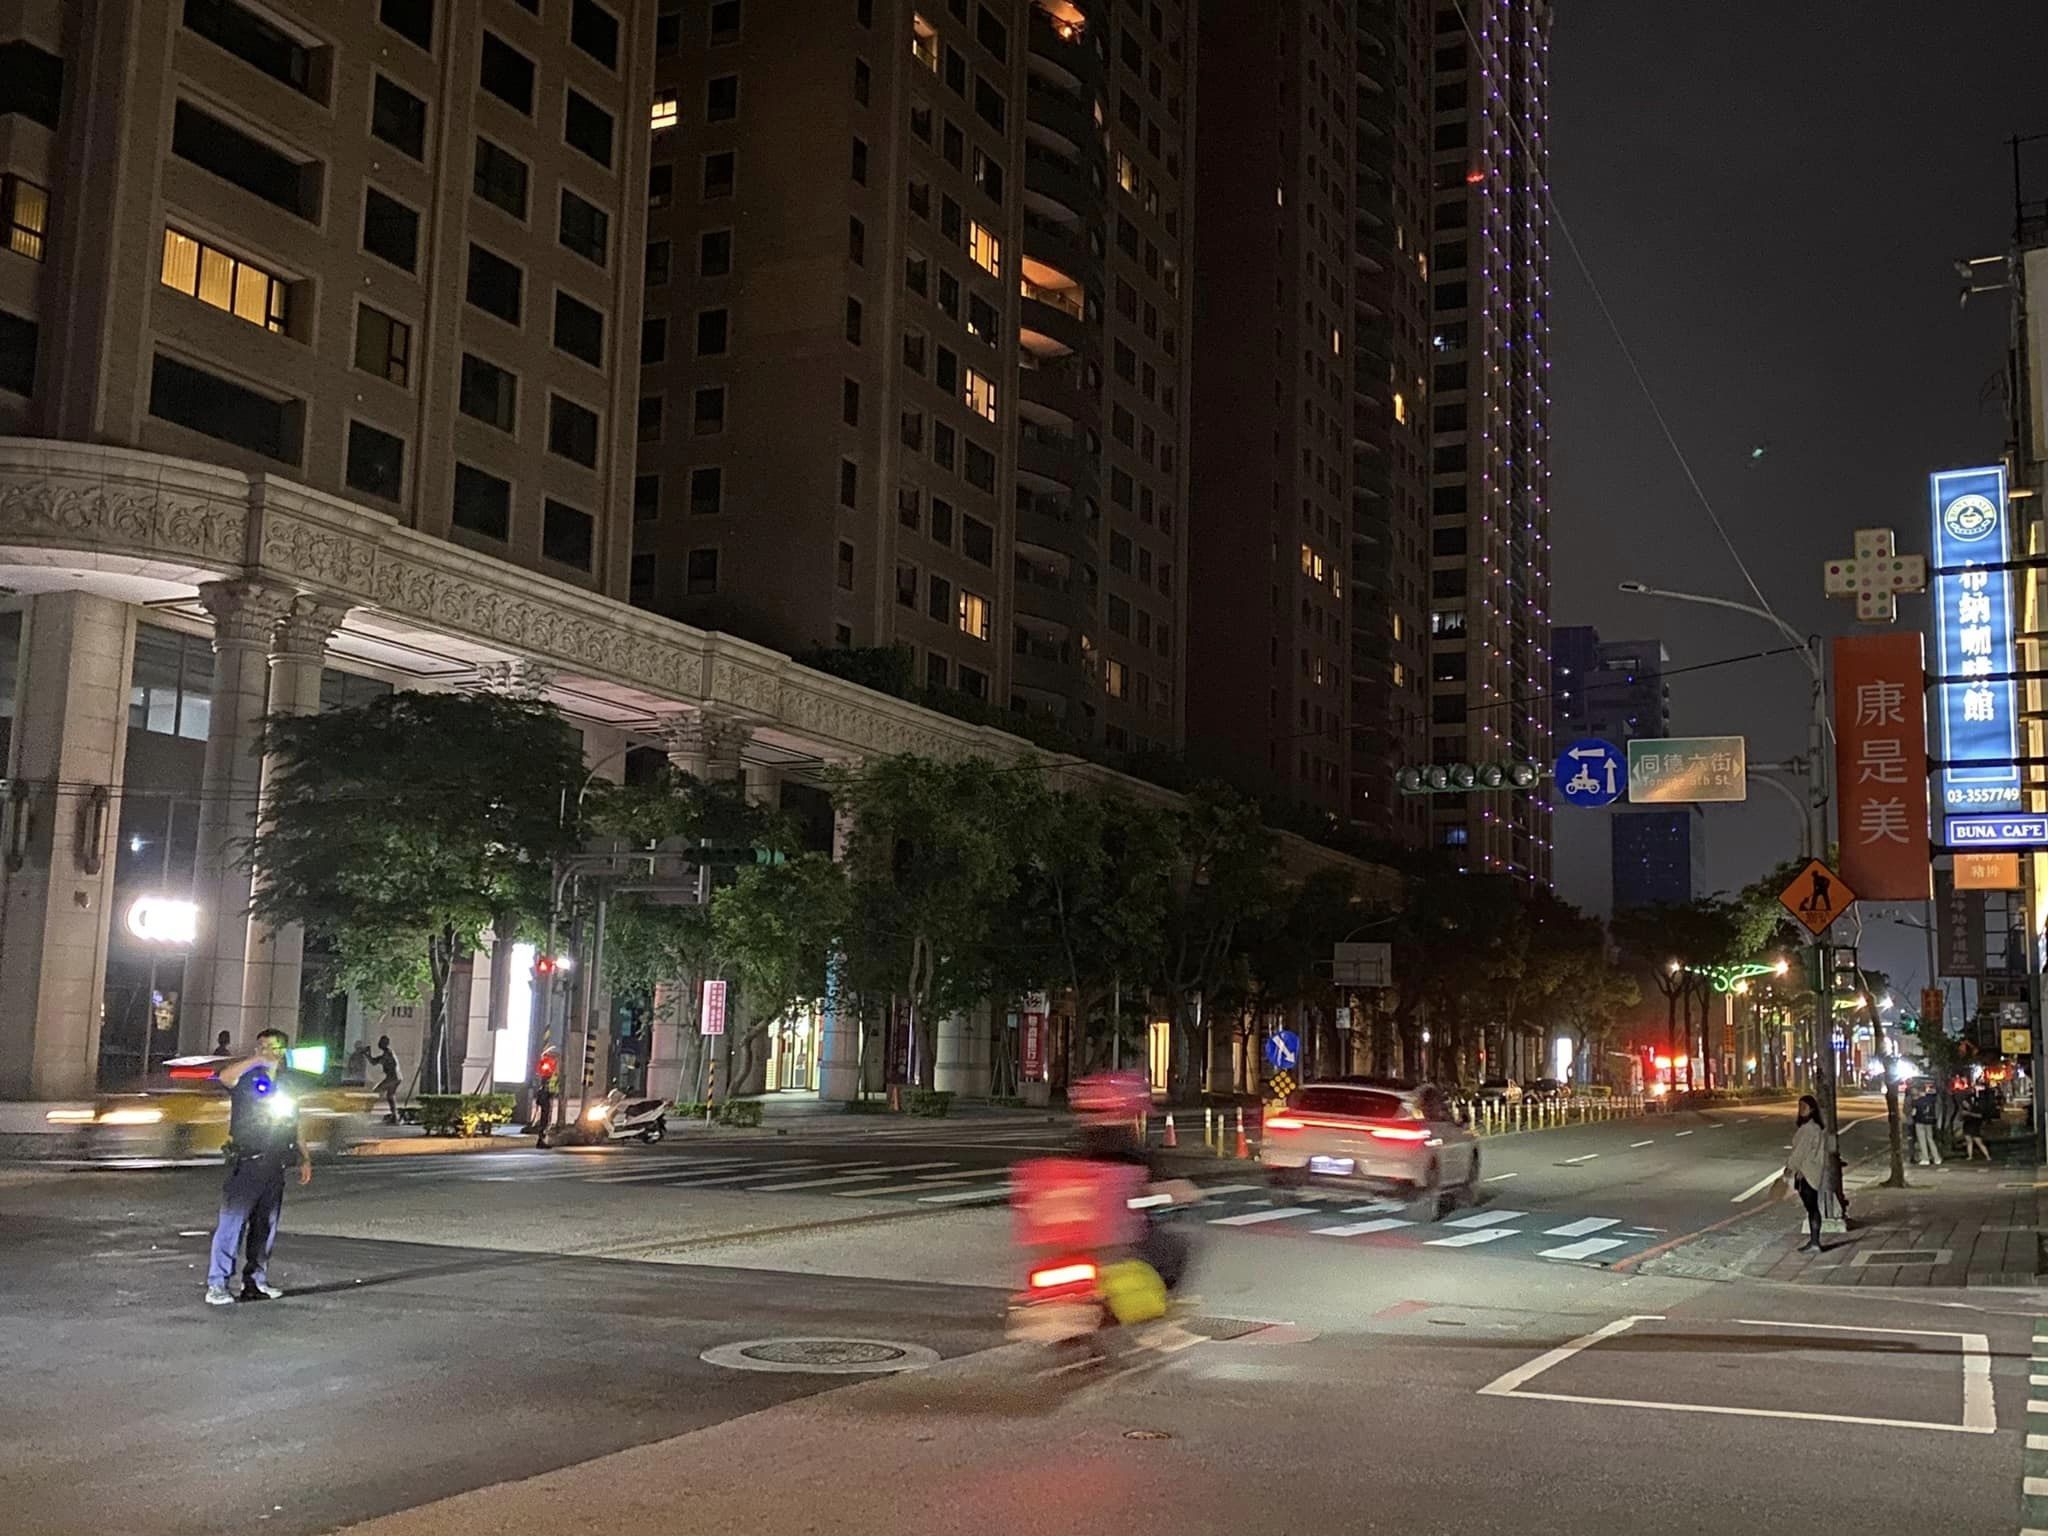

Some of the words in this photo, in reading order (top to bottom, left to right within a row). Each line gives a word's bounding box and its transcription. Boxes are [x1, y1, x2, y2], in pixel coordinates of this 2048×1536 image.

[1640, 753, 1731, 773] 同德六街
[1855, 679, 1910, 845] 康是美
[1947, 788, 2019, 804] 03-3557749
[1957, 826, 1997, 838] BUNA
